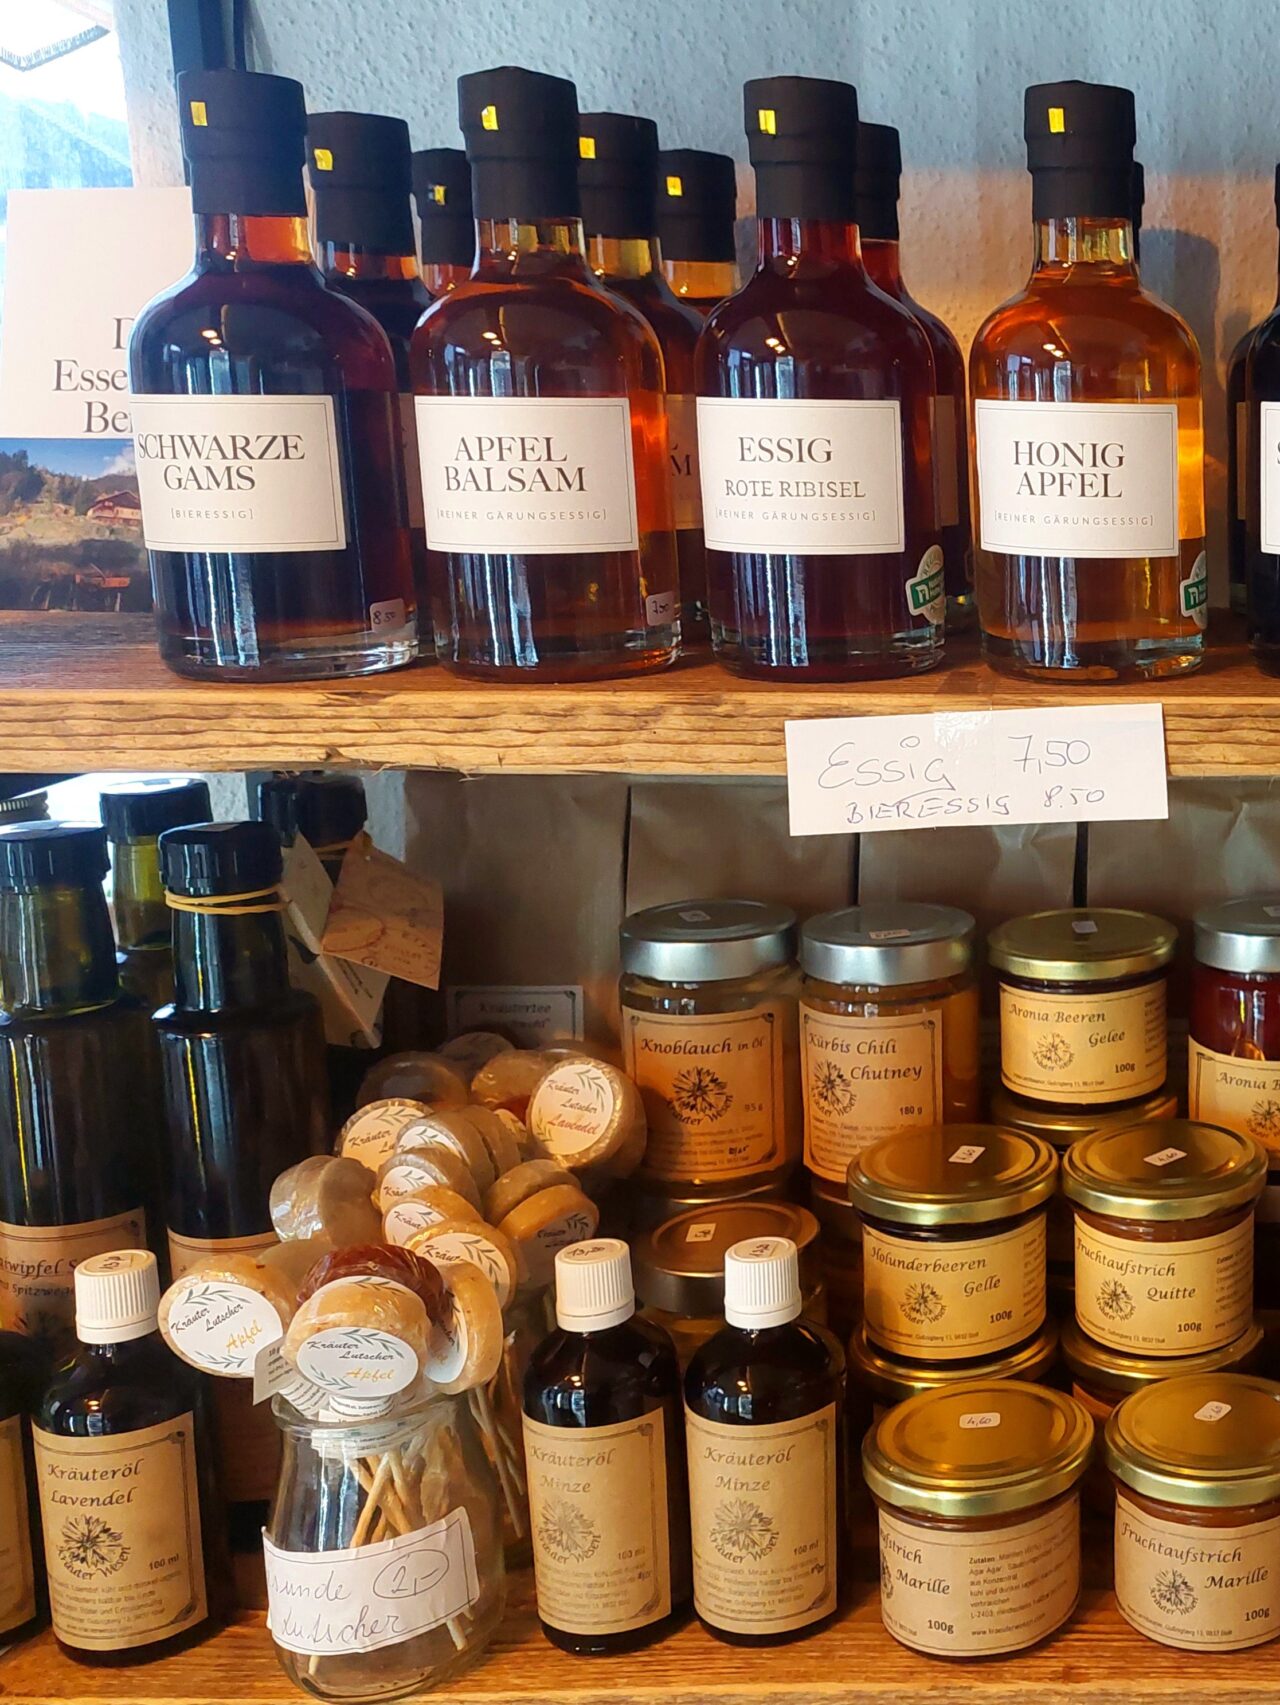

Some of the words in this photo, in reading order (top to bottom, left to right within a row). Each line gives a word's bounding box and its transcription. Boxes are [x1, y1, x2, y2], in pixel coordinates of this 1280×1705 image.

[83, 402, 133, 433] Be
[138, 434, 305, 461] SCHWARZE
[454, 436, 567, 462] APFEL
[738, 437, 833, 464] ESSIG
[1013, 441, 1126, 469] HONIG
[163, 465, 256, 491] GAMS
[445, 466, 588, 493] BALSAM
[1016, 472, 1123, 499] APFEL
[725, 479, 775, 499] ROTE
[778, 480, 866, 500] RIBISEL
[1007, 734, 1092, 775] 7,50
[1009, 1004, 1050, 1022] Aronia
[1055, 1011, 1106, 1023] Beeren
[640, 1038, 732, 1056] Knoblauch
[807, 1033, 851, 1054] Kürbis
[856, 1038, 897, 1055] Chili
[1088, 1029, 1127, 1048] Gelee
[850, 1065, 923, 1083] Chutney
[1114, 1062, 1136, 1074] 100g
[1216, 1071, 1267, 1090] Aronia
[348, 1129, 393, 1148] Kräuter
[870, 1247, 988, 1273] Holunderbeeren
[1076, 1238, 1177, 1277] Fruchtaufstrich
[962, 1276, 1001, 1297] Gelle
[1145, 1285, 1197, 1303] Quitte
[171, 1308, 210, 1333] Kräuter
[206, 1303, 243, 1331] Lutscher
[989, 1310, 1013, 1324] 100g
[1177, 1322, 1202, 1334] 100g
[226, 1320, 262, 1353] Apfel
[307, 1340, 360, 1350] Kräuter
[338, 1350, 394, 1361] Lutscher
[343, 1366, 395, 1382] Apfel
[529, 1445, 617, 1468] Kräuteröl
[703, 1444, 796, 1467] Kräuteröl
[47, 1458, 144, 1482] Kräuteröl
[539, 1474, 592, 1494] Minze
[714, 1474, 771, 1492] Minze
[50, 1486, 134, 1508] Lavendel
[1121, 1520, 1242, 1564] Fruchtaufstrich
[896, 1568, 950, 1595] Marille
[1205, 1566, 1269, 1591] Marille
[1244, 1607, 1270, 1622] 100g
[928, 1619, 954, 1634] 100g
